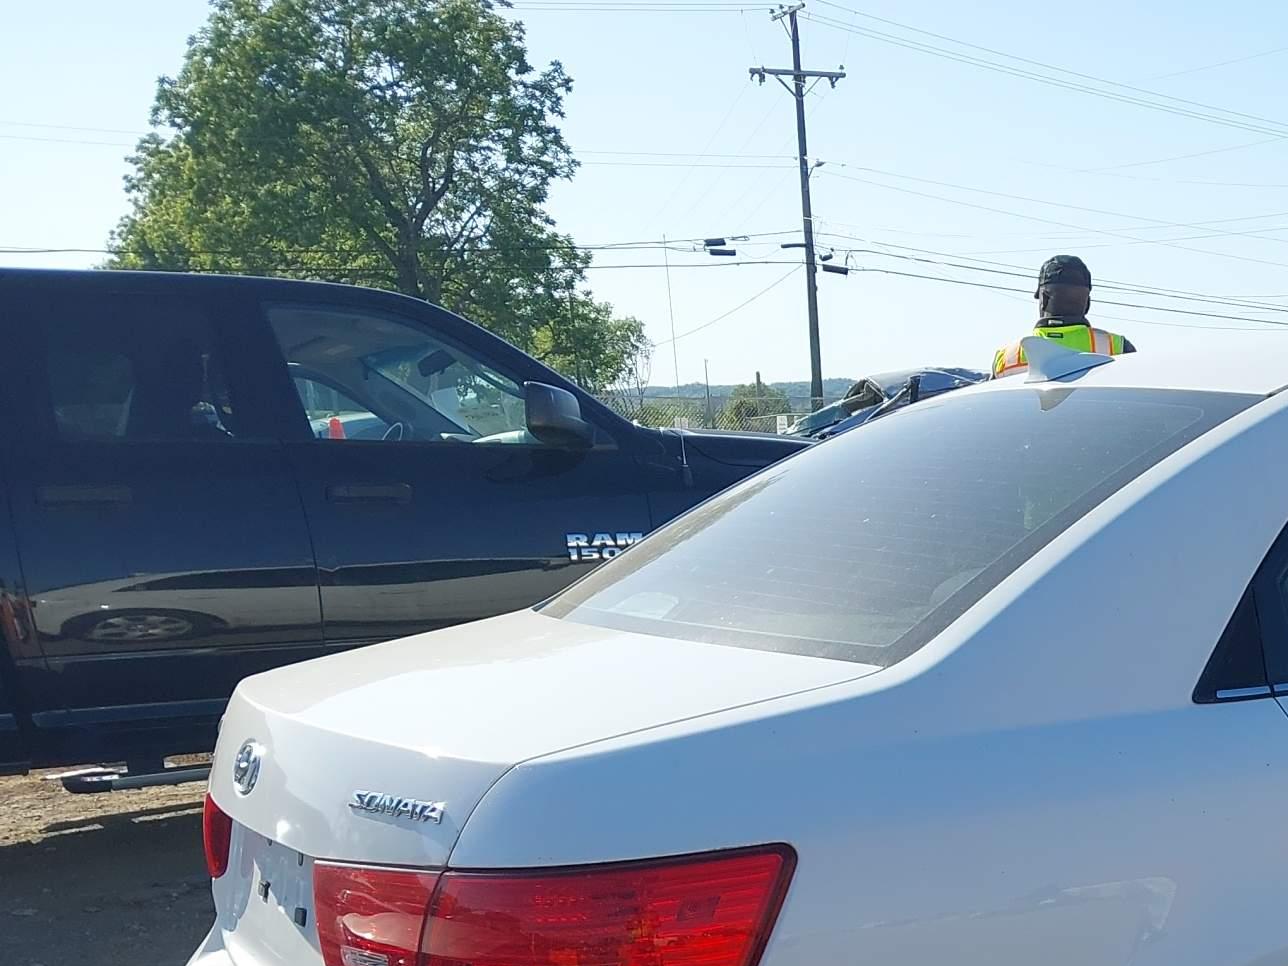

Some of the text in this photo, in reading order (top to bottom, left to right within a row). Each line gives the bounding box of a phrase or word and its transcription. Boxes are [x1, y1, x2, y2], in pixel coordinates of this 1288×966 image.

[566, 532, 643, 547] RAM
[567, 547, 622, 561] 150
[348, 789, 447, 824] SONATA
